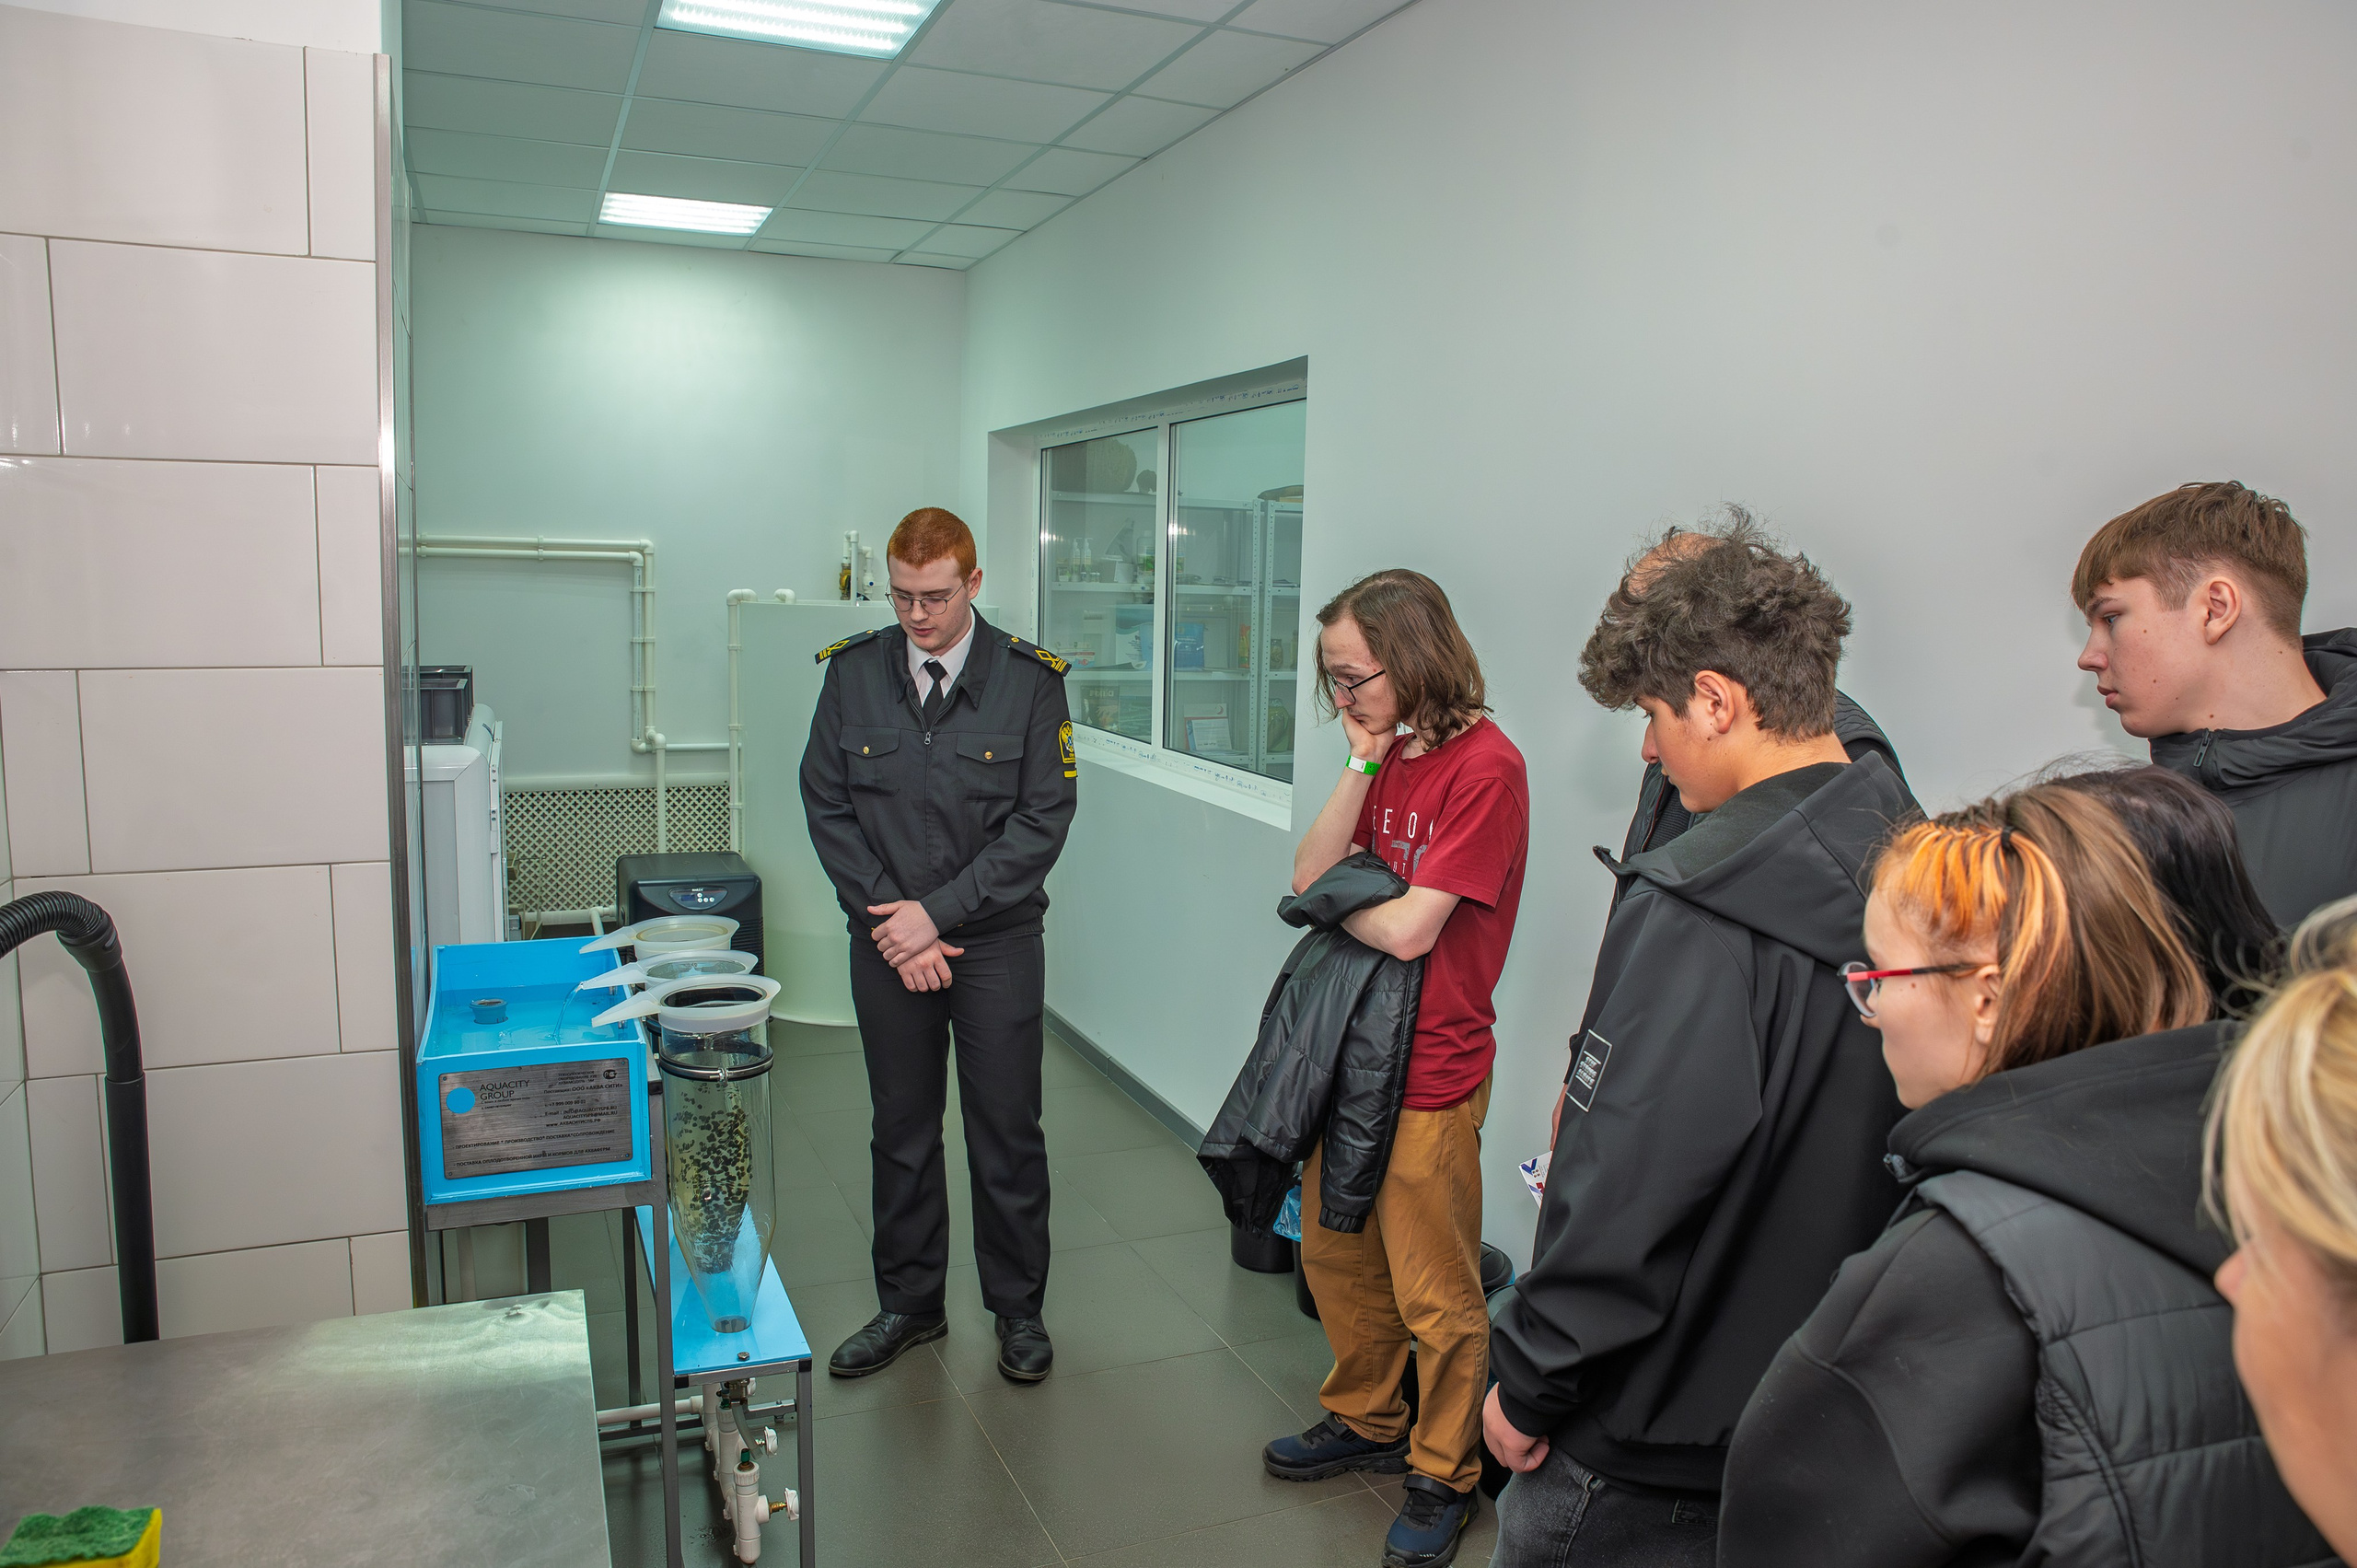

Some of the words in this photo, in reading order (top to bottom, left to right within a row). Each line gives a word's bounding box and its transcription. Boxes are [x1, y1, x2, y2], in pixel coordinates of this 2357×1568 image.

[479, 1079, 530, 1092] AQUACITY
[480, 1090, 515, 1100] GROUP
[455, 1141, 500, 1149] ПРОЕКТИРОВАНИЕ
